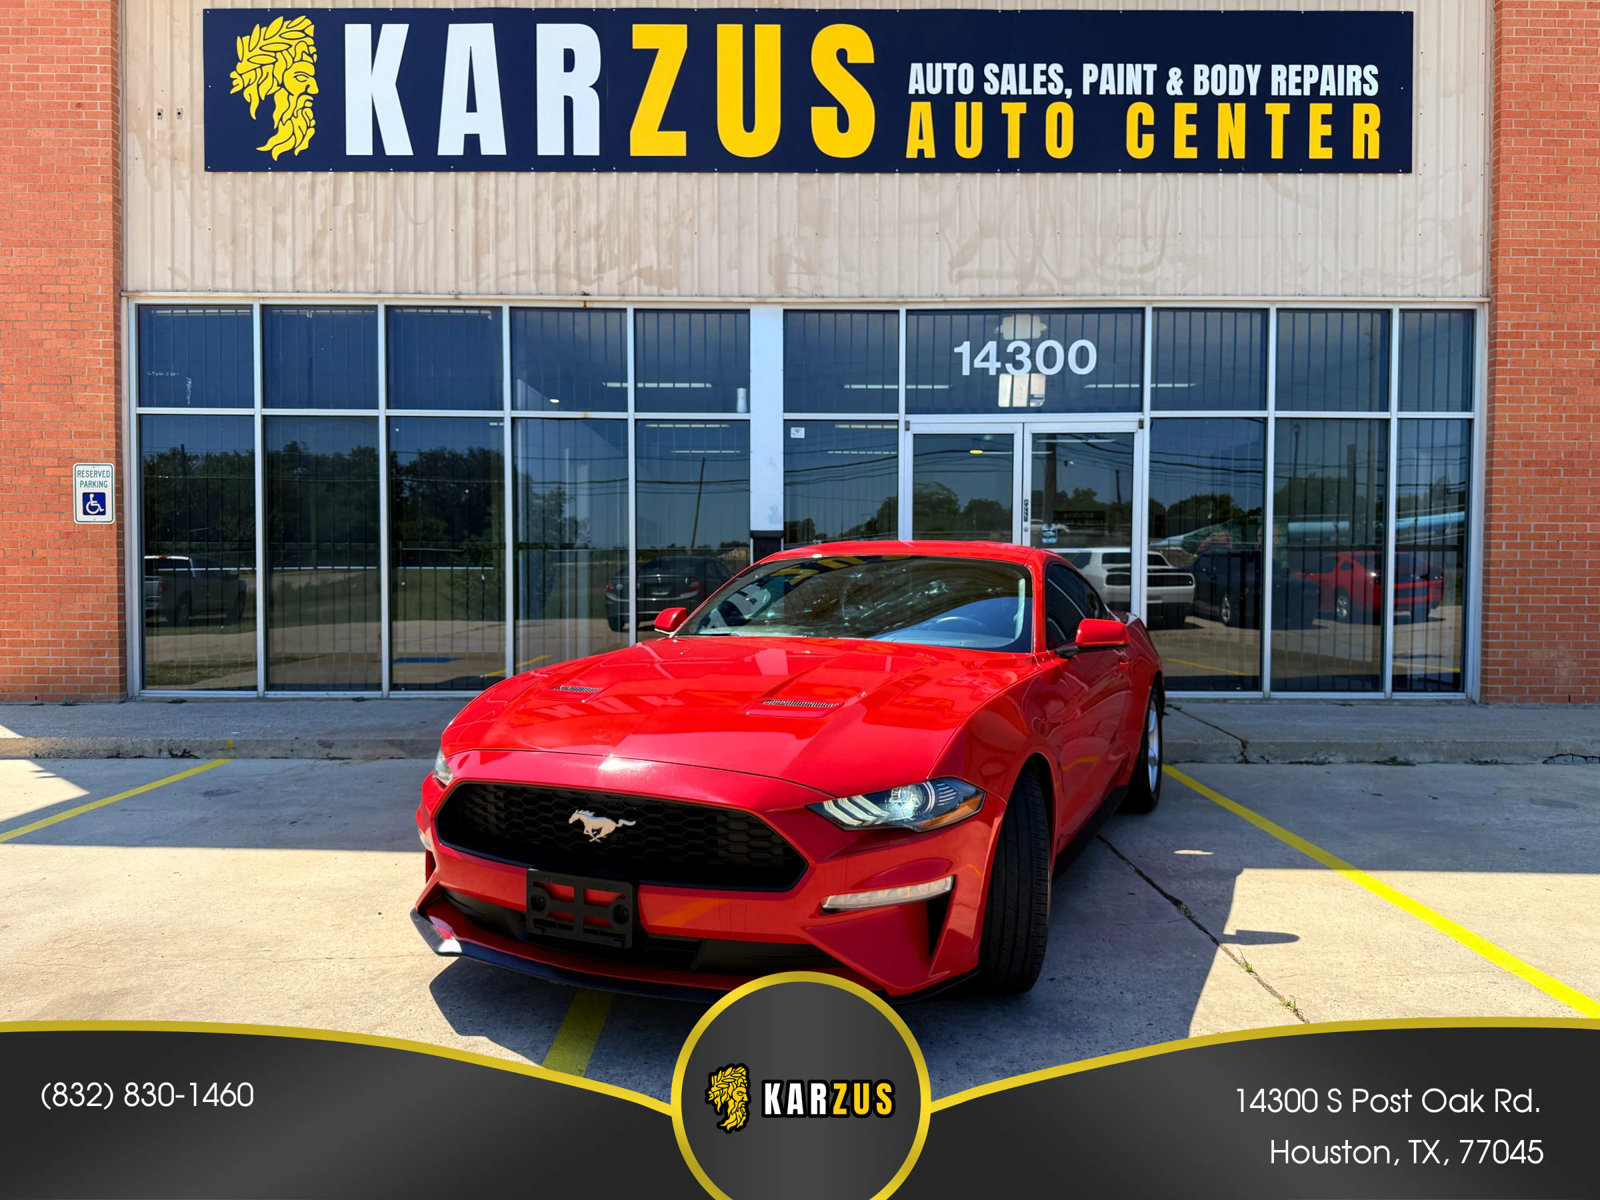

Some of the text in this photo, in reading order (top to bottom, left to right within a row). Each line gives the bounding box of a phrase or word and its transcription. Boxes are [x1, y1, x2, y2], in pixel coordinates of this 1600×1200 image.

[344, 23, 876, 158] KARZUS
[908, 62, 1379, 99] AUTO SALES, PAINT & BODY REPAIRS
[905, 101, 1381, 160] AUTO CENTER
[953, 339, 1097, 376] 14300
[77, 470, 111, 478] RESERVED
[79, 480, 109, 488] PARKING
